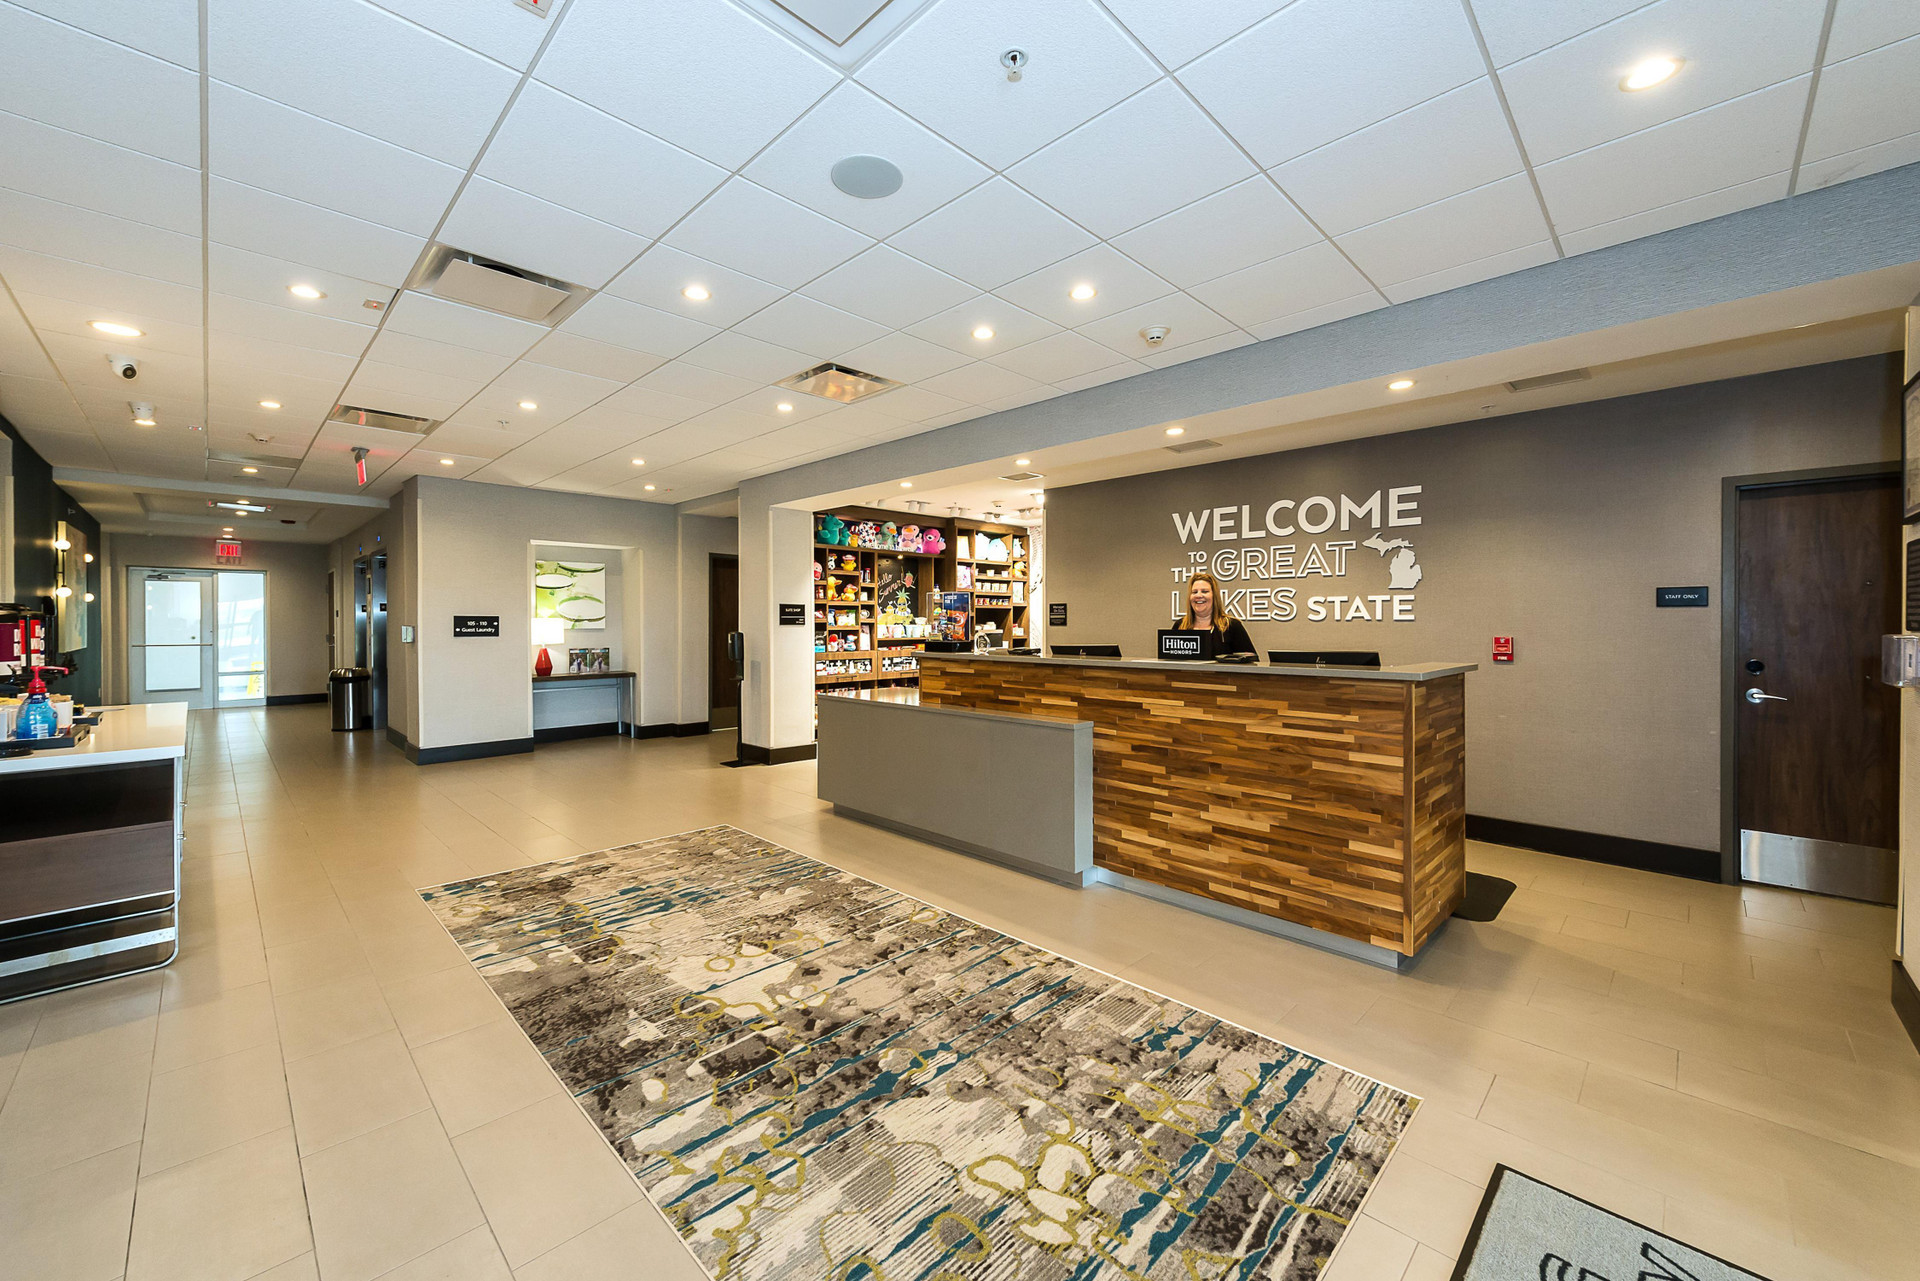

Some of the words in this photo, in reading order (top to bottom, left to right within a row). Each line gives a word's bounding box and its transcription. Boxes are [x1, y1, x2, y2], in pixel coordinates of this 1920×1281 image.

[1171, 485, 1422, 545] WELCOME
[220, 544, 238, 556] EXIT
[1187, 551, 1208, 564] TO
[1211, 540, 1356, 582] GREAT
[1171, 587, 1298, 622] LKES
[1307, 594, 1416, 622] STATE
[1166, 639, 1197, 649] Hilton
